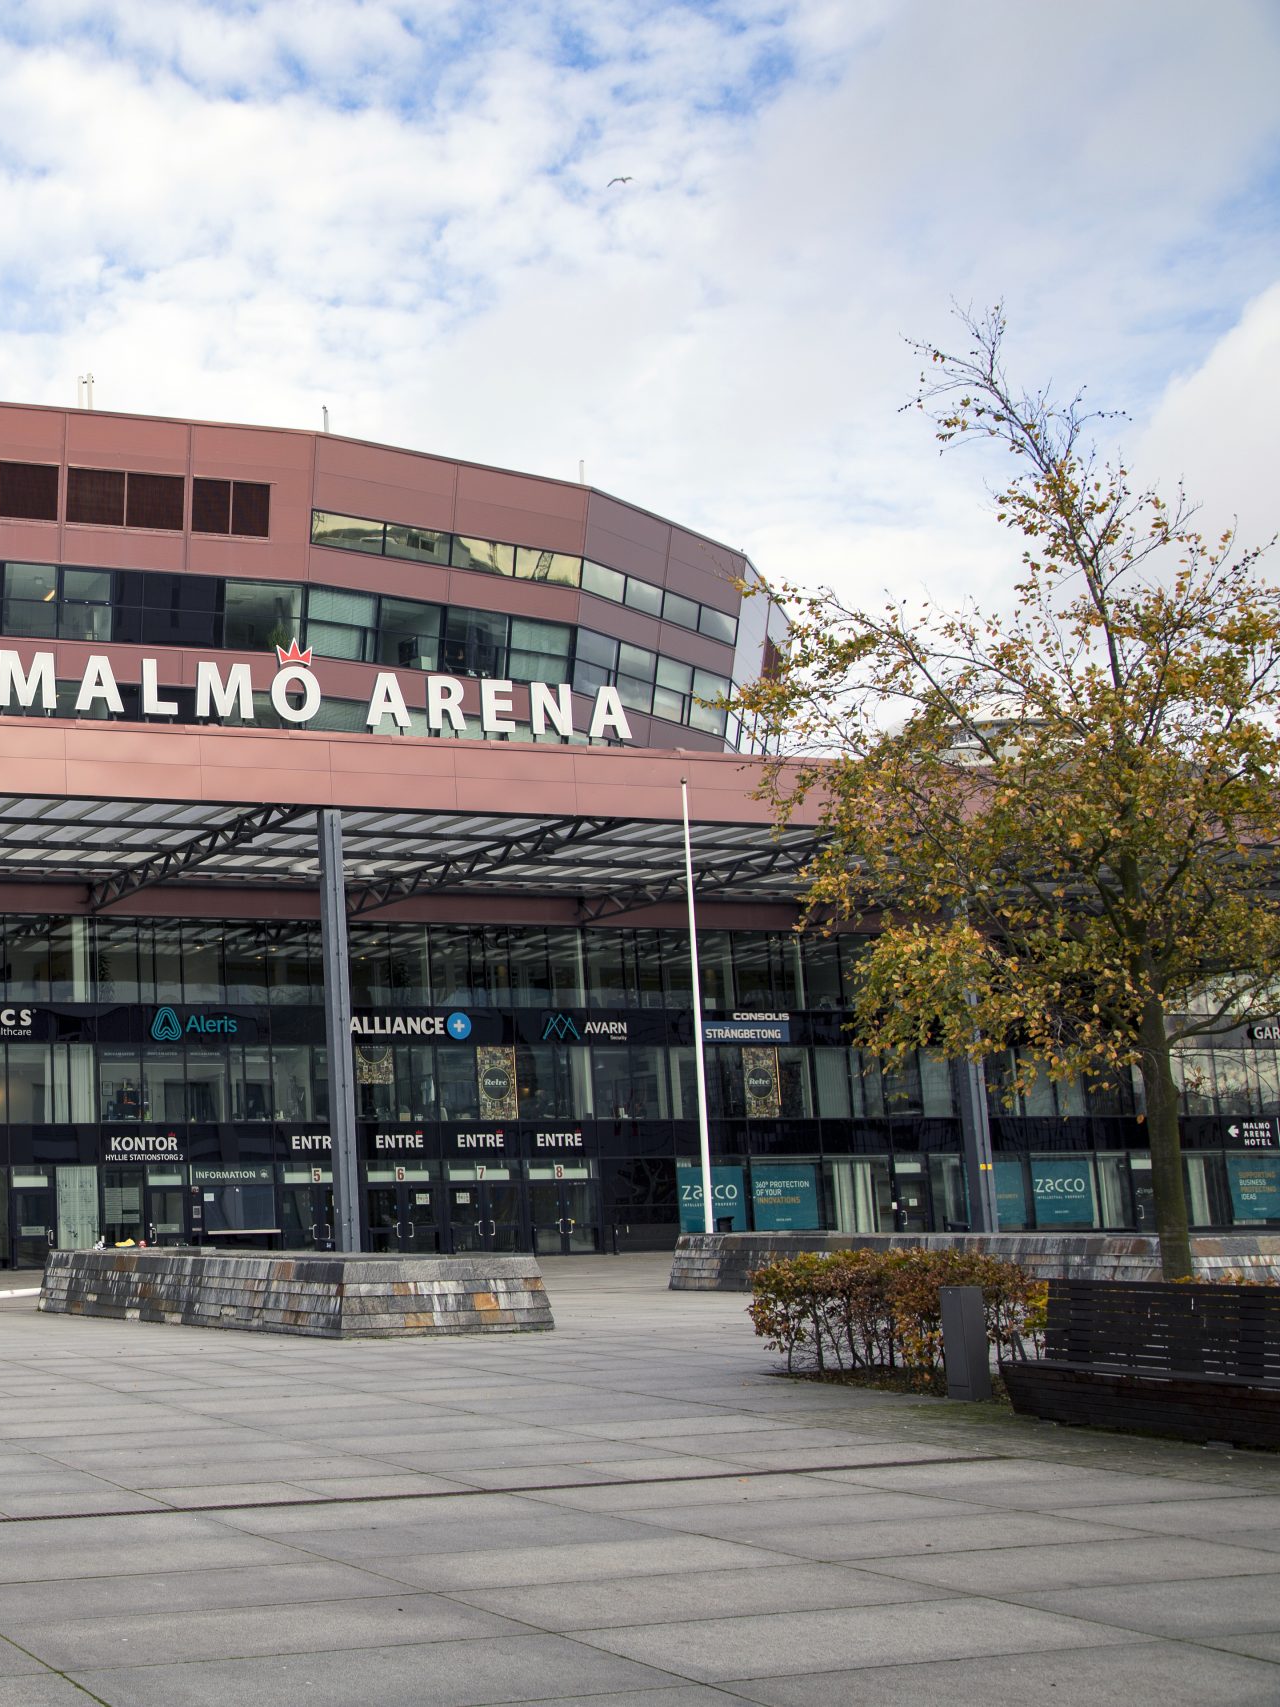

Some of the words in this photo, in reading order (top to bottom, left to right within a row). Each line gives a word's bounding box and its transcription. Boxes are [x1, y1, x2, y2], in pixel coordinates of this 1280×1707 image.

[366, 672, 633, 739] ARENA
[732, 1012, 790, 1021] CONSOLIS
[185, 1014, 238, 1034] Aleris
[350, 1016, 446, 1035] ALLIANCE
[584, 1021, 628, 1034] AVARN
[1243, 1130, 1271, 1138] ARENA
[110, 1136, 178, 1151] KONTOR
[1244, 1138, 1272, 1146] HOTEL
[105, 1153, 128, 1161] HYLLIE
[129, 1153, 179, 1161] STATIONSTORG
[179, 1153, 184, 1161] 2
[195, 1170, 256, 1179] INFORMATION
[313, 1169, 321, 1182] 5
[397, 1168, 405, 1181] 6
[477, 1167, 485, 1179] 7
[556, 1166, 563, 1178] 8
[769, 1180, 810, 1188] PROTECTION
[1239, 1178, 1267, 1186] BUSINESS
[681, 1184, 738, 1200] zaco
[756, 1188, 765, 1196] OF
[765, 1188, 782, 1196] YOUR
[757, 1196, 801, 1204] INNOVATIONS
